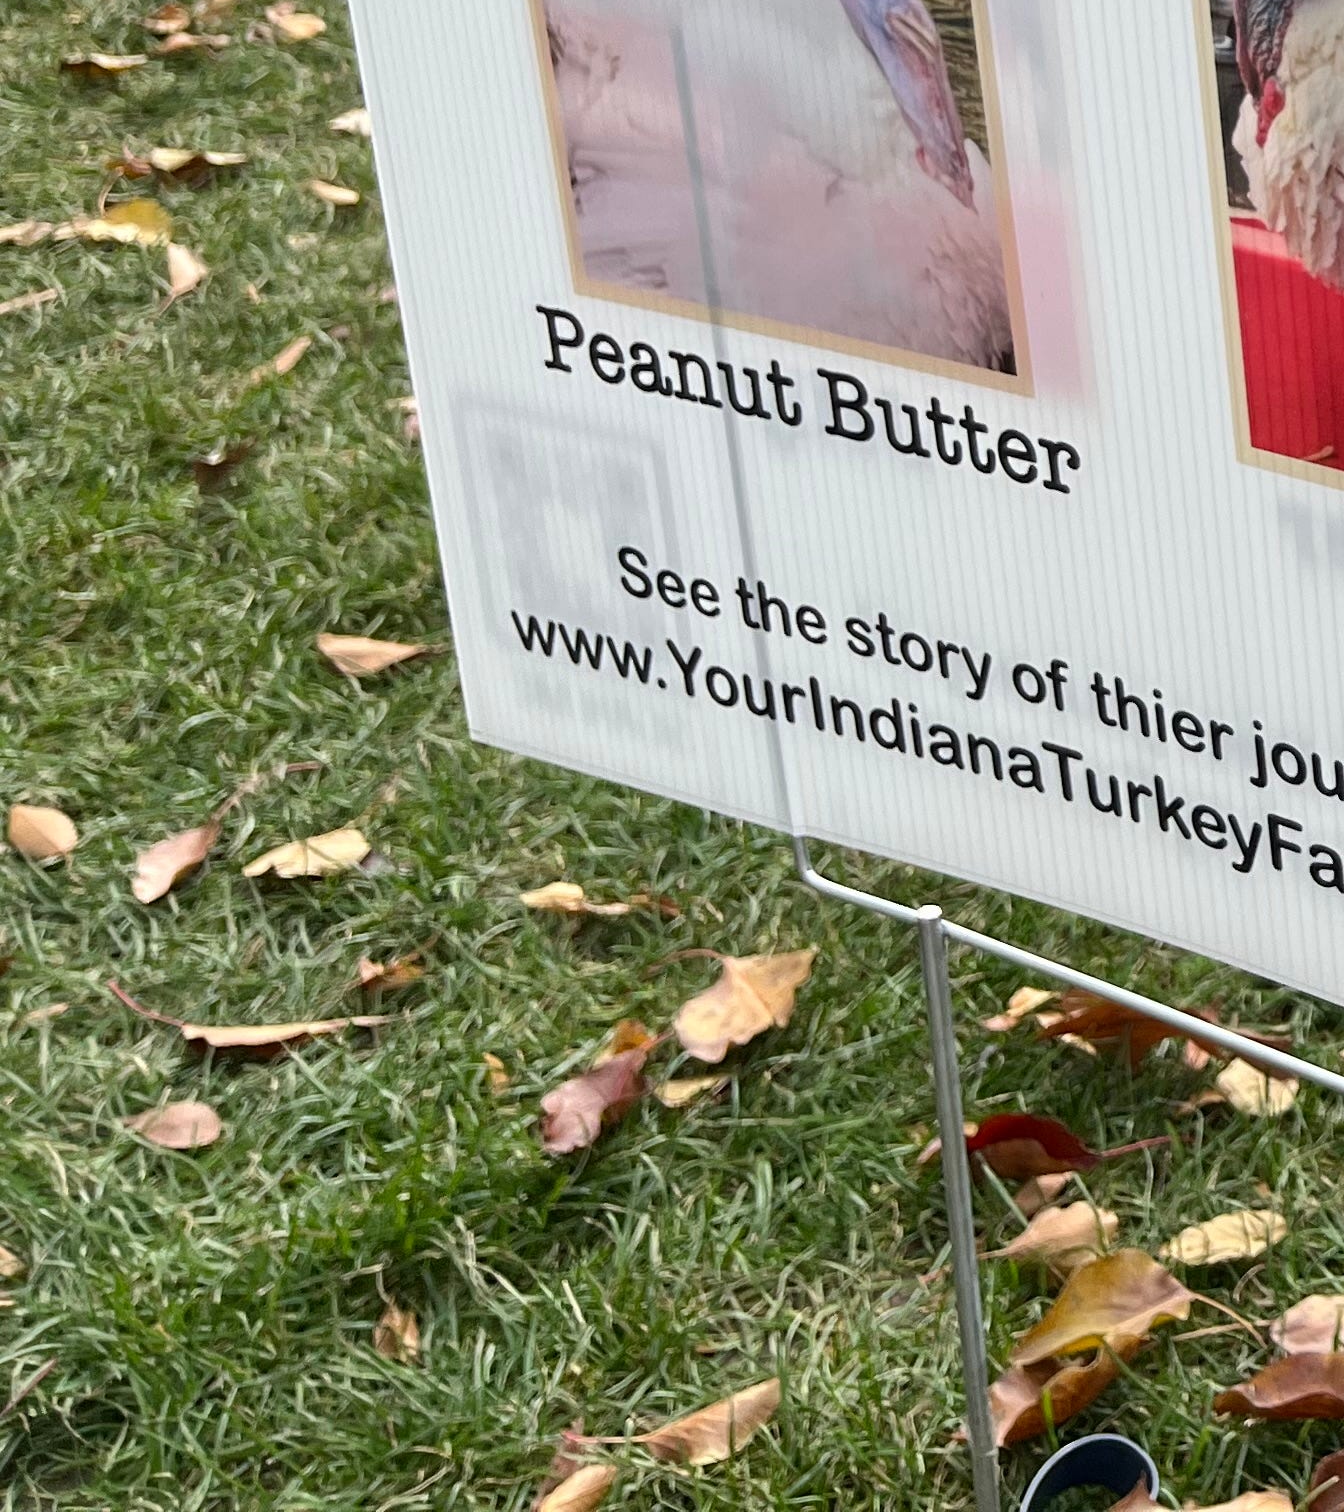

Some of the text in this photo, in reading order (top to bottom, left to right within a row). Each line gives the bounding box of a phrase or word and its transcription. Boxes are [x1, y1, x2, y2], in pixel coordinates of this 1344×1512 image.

[535, 305, 1082, 494] Peanut Butter
[617, 546, 721, 618] See
[735, 577, 827, 645] the
[845, 612, 992, 701] story
[1012, 658, 1069, 712] of
[1090, 671, 1234, 761] thier
